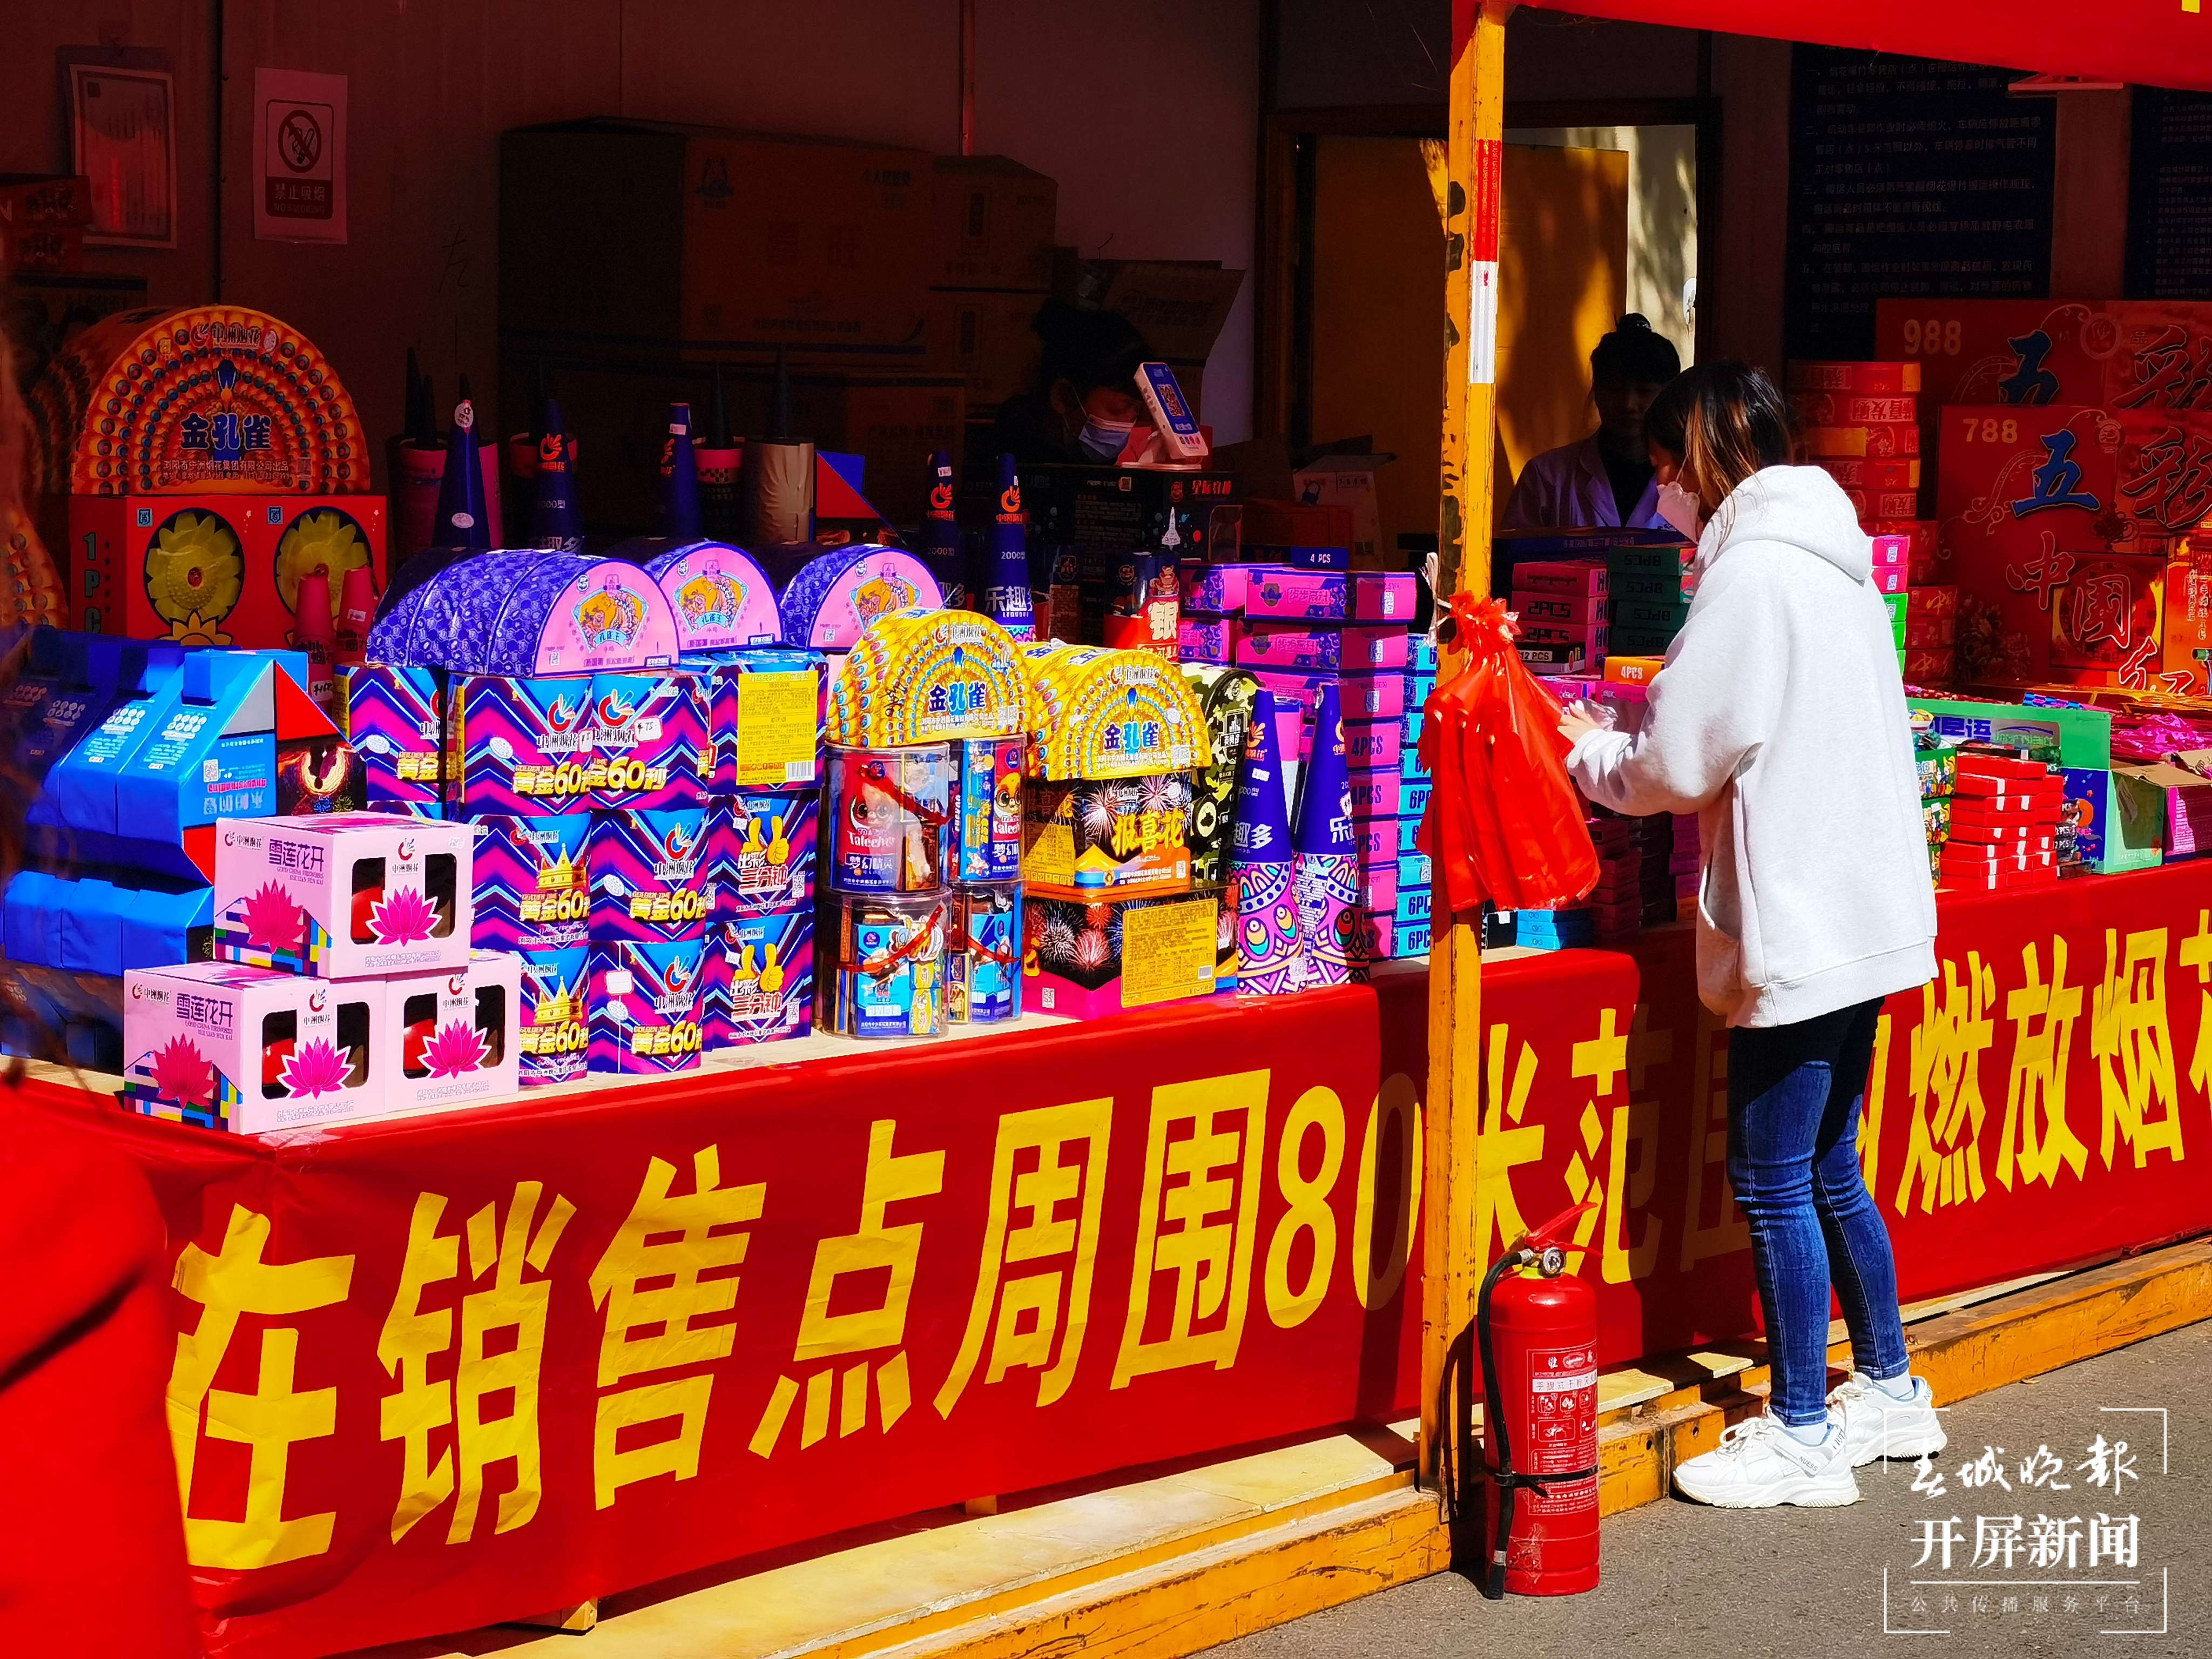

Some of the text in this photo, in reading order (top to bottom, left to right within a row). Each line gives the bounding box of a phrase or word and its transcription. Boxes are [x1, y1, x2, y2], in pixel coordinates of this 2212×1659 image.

[274, 184, 325, 202] 禁止吸烟
[1904, 320, 1961, 355] 988
[180, 413, 271, 451] 金孔雀
[1962, 419, 2018, 443] 788
[1318, 553, 1331, 563] PCS
[1532, 652, 1549, 660] PCS
[1621, 665, 1643, 679] 4PCS
[928, 681, 987, 713] 金孔雀
[1104, 722, 1159, 751] 金孔雀
[1351, 736, 1384, 757] 4PCS
[1112, 809, 1186, 858] 报喜花
[1355, 833, 1381, 854] PCS
[268, 839, 324, 872] 雪莲花开
[392, 862, 419, 874] 中洲烟花
[738, 866, 788, 892] 三分钟
[177, 993, 233, 1027] 雪莲花开
[731, 992, 781, 1017] 三分钟
